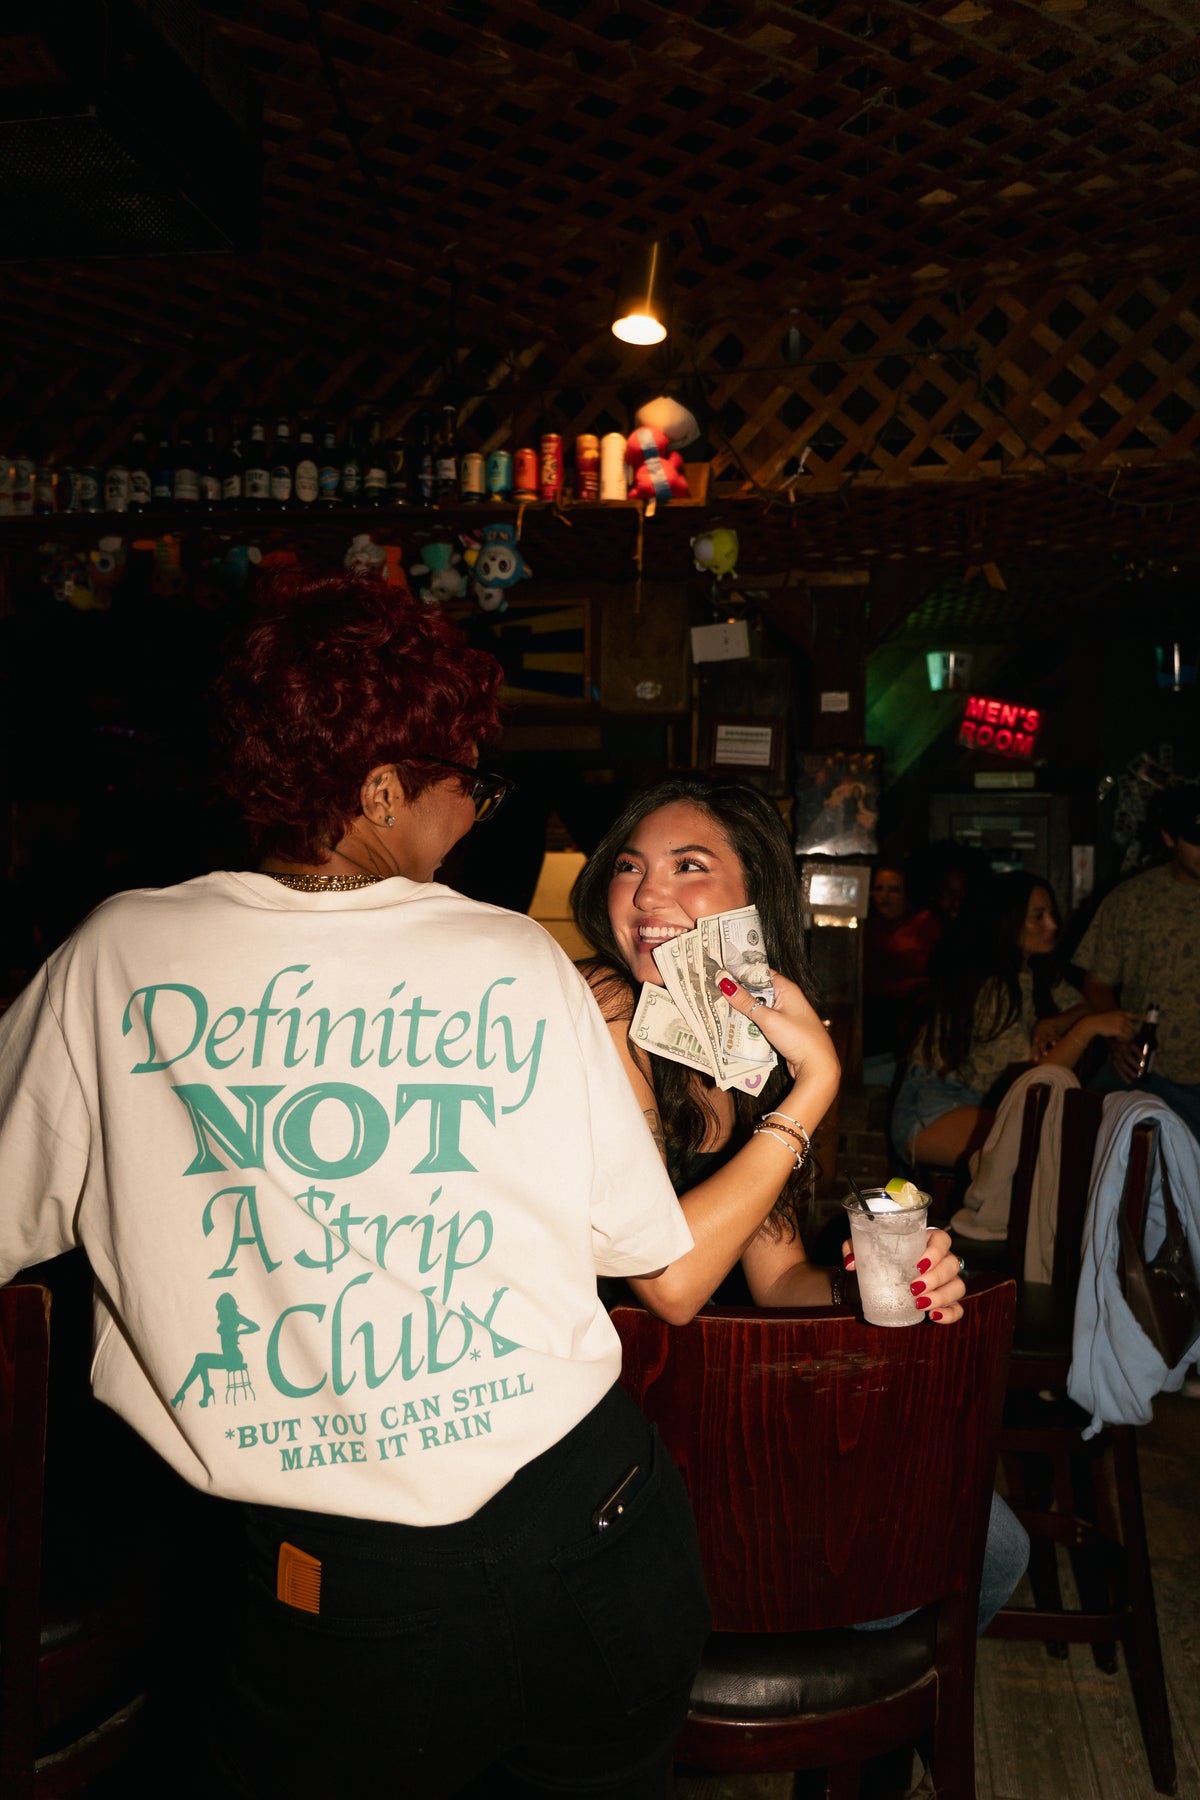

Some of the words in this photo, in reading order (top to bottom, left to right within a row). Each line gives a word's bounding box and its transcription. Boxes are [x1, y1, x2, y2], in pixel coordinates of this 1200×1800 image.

[960, 721, 1035, 755] ROOM
[966, 696, 1040, 732] MEN'S
[122, 964, 547, 1115] Definitely
[171, 1081, 496, 1180] NOT
[202, 1185, 283, 1280] A
[311, 1412, 368, 1438] YOU
[380, 1394, 441, 1431] CAN
[453, 1373, 534, 1413] STILL
[280, 1440, 367, 1471] MAKE
[376, 1433, 408, 1461] IT
[421, 1410, 493, 1450] RAIN
